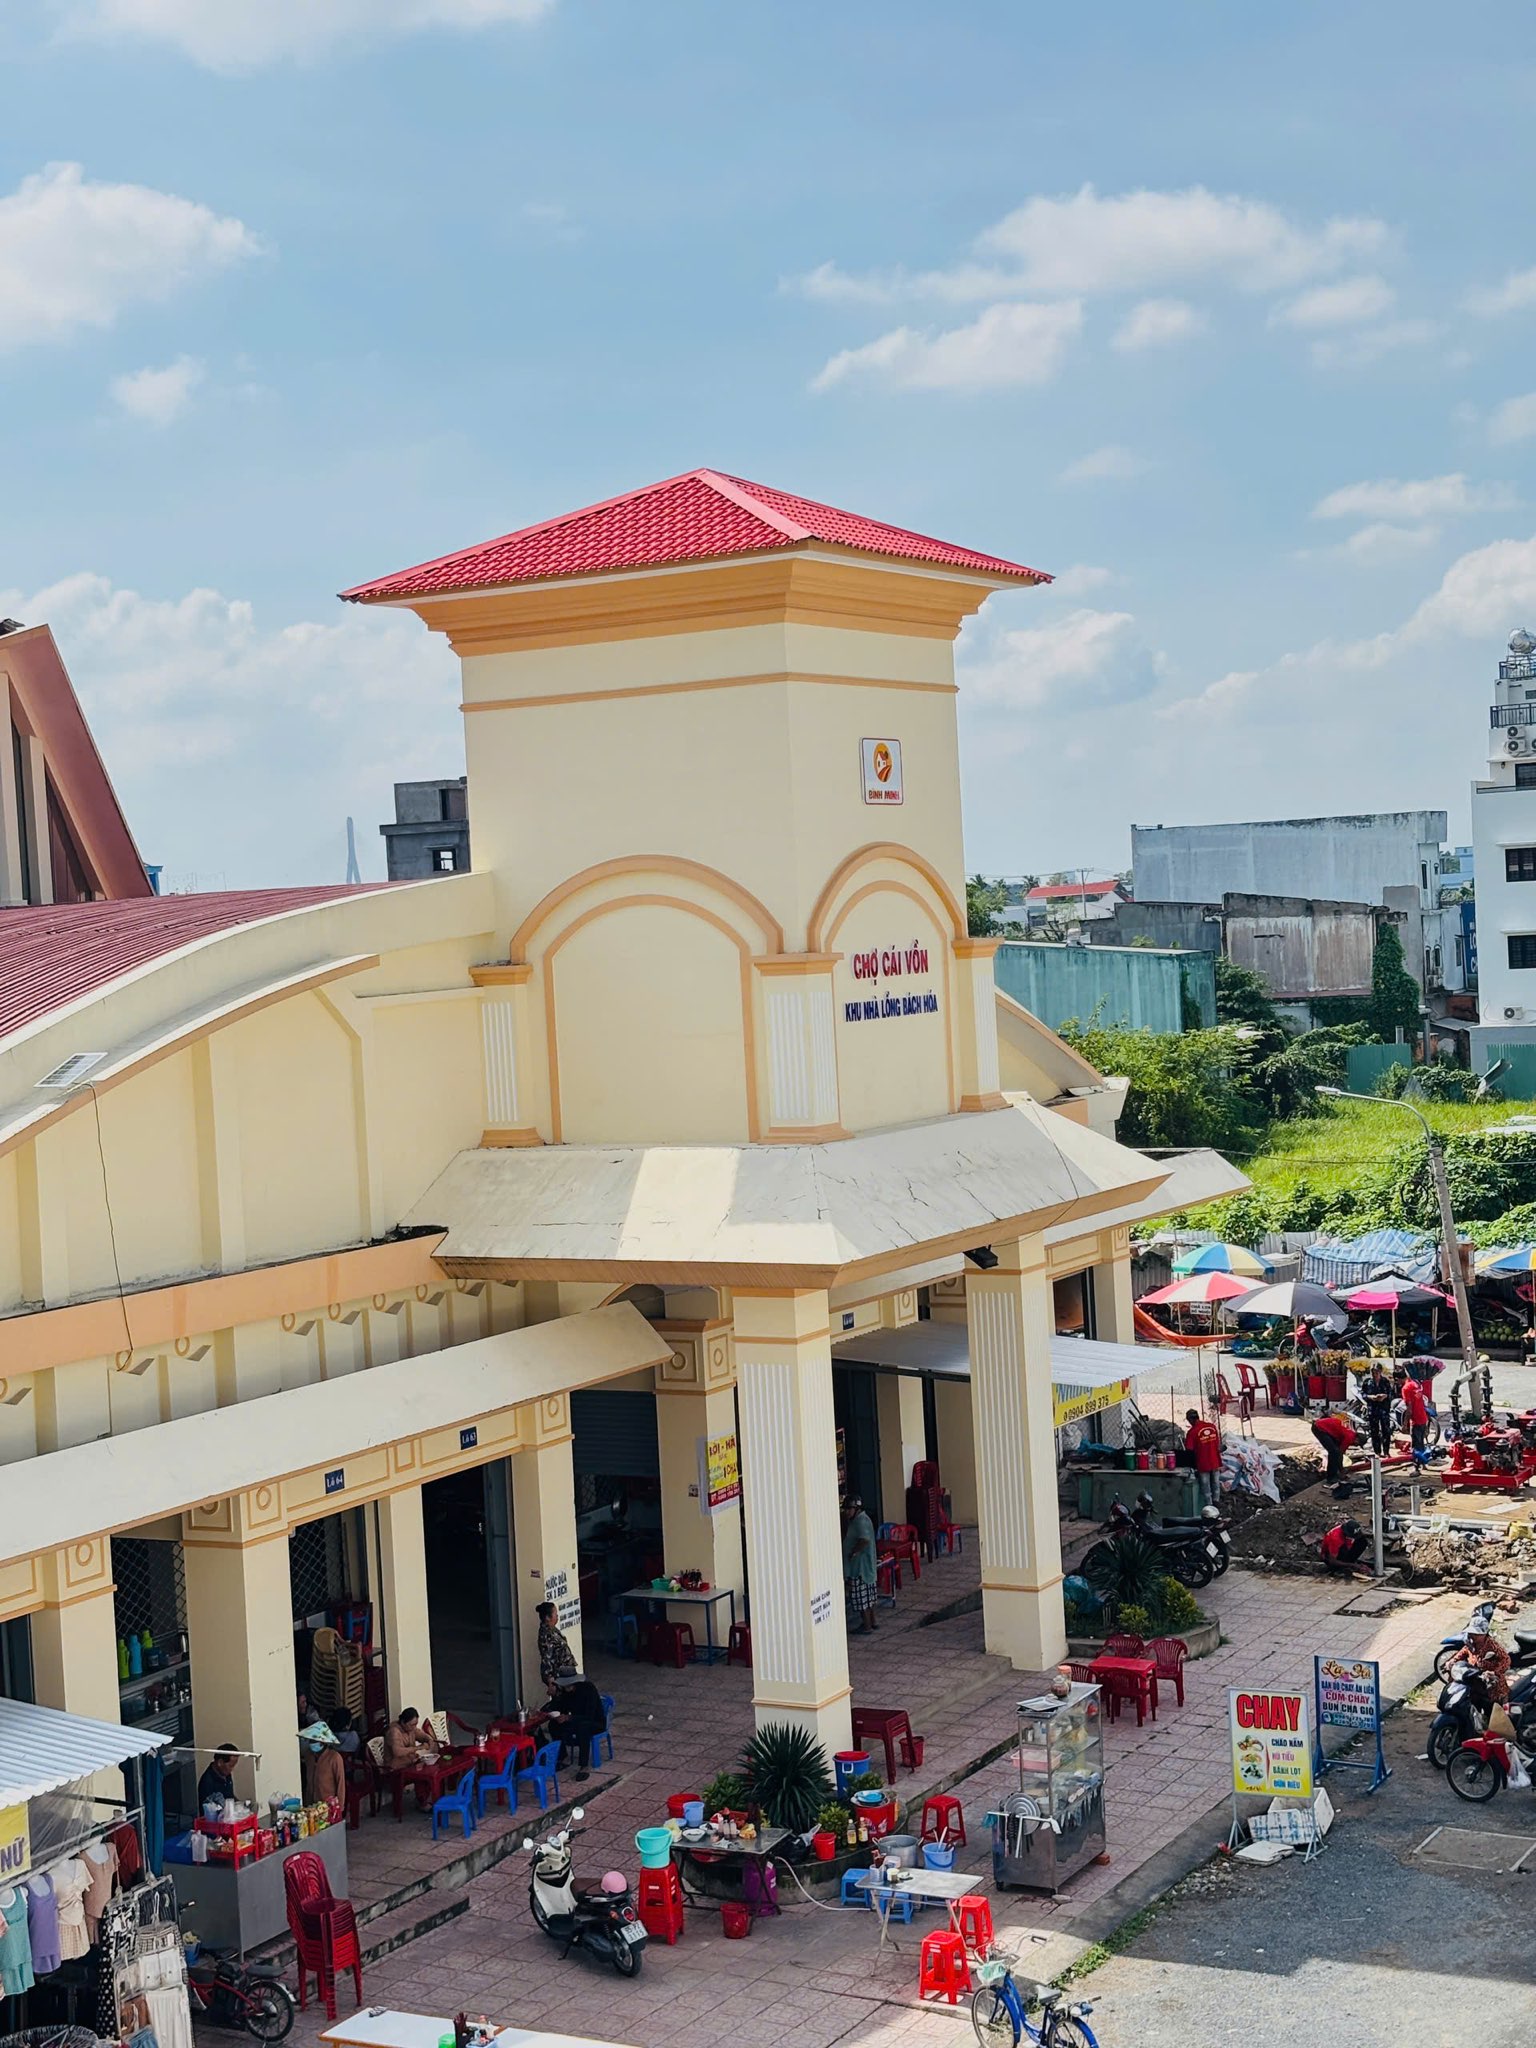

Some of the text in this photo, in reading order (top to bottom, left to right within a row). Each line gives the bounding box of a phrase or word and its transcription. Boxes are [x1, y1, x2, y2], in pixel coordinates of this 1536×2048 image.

[853, 948, 879, 986] CHỢ
[882, 945, 902, 977] CÁI
[845, 1002, 862, 1022] KHU
[863, 995, 880, 1020] NHÀ
[902, 992, 922, 1016] BÁCH
[923, 989, 939, 1013] HÓA
[327, 1477, 335, 1488] Lô
[1236, 1693, 1301, 1732] CHAY
[1347, 1694, 1370, 1705] CHAY
[0, 1837, 25, 1873] NỮ
